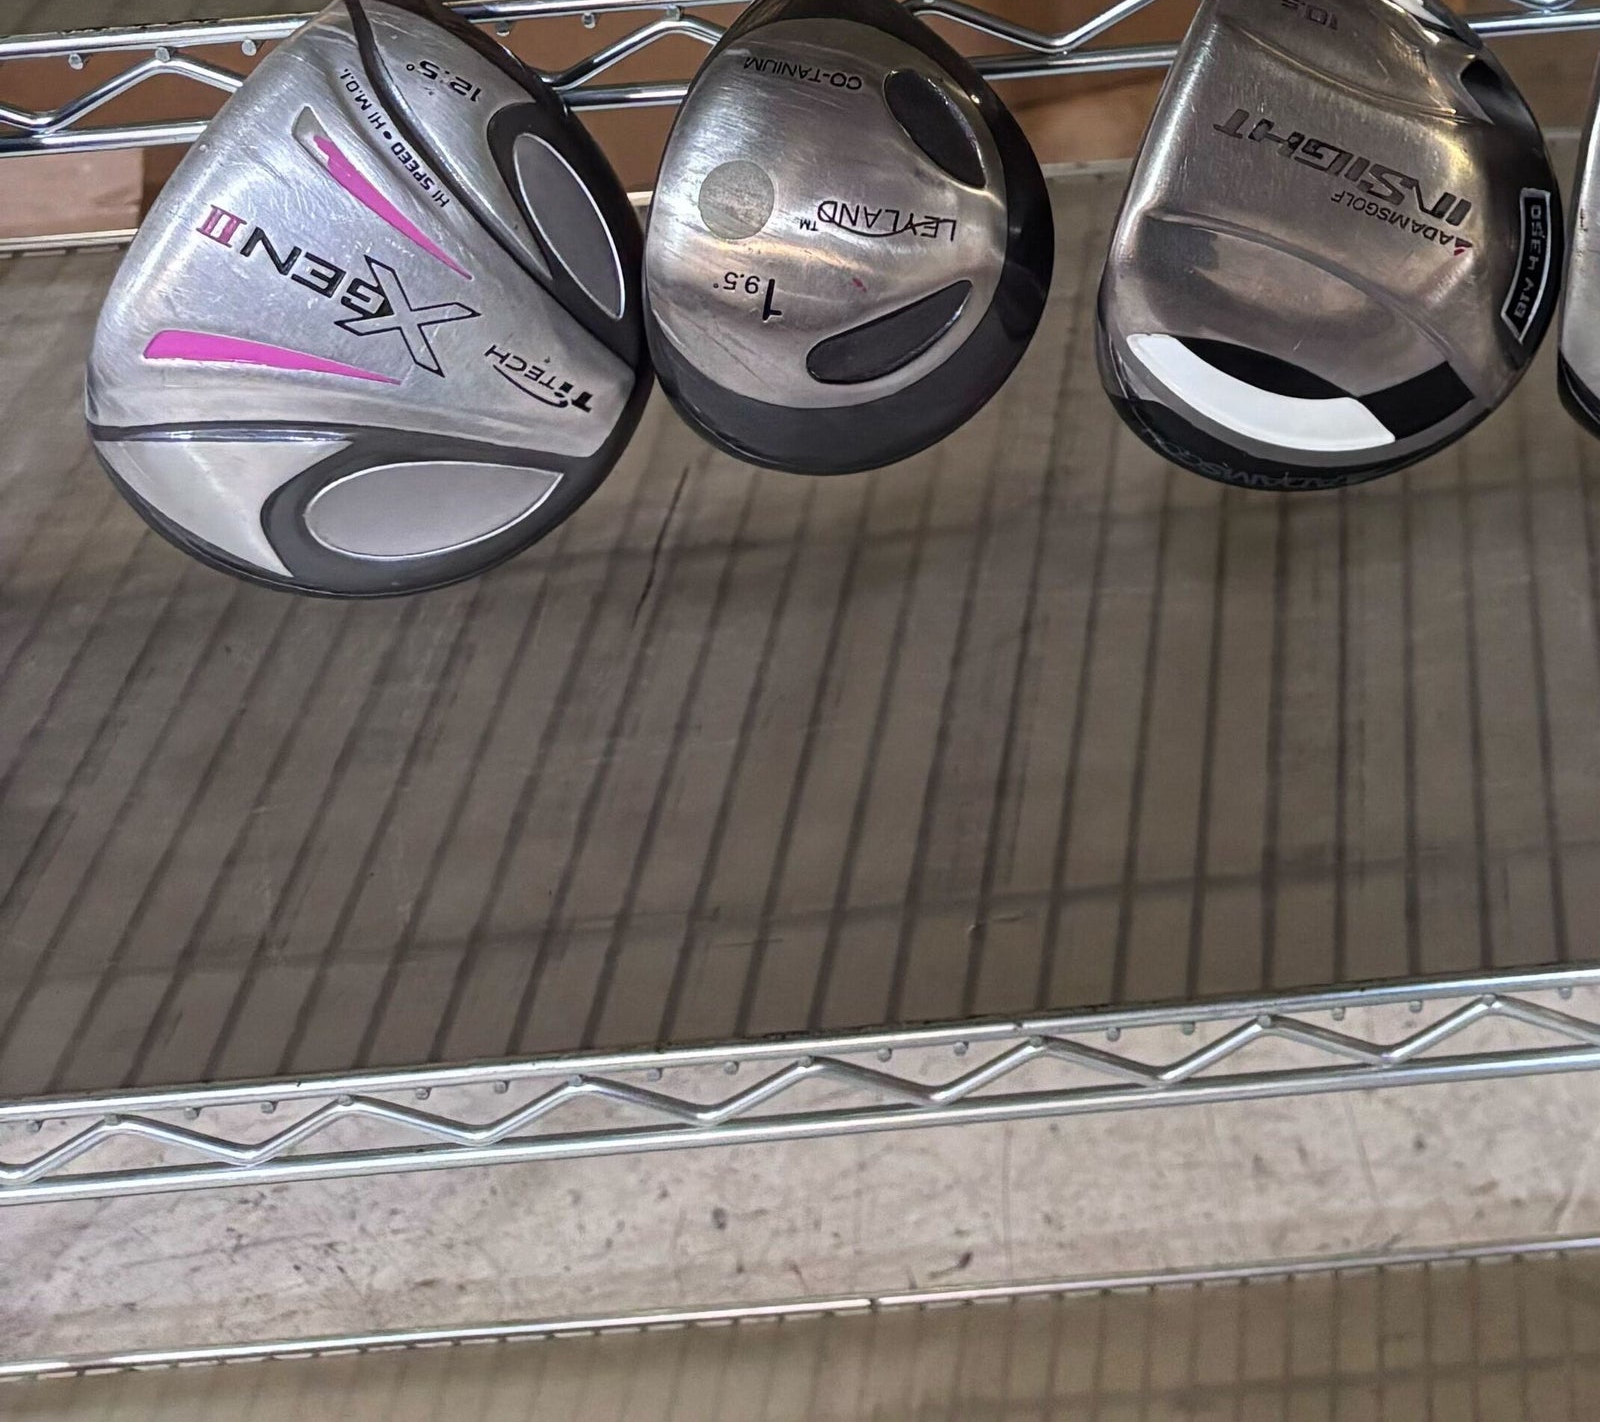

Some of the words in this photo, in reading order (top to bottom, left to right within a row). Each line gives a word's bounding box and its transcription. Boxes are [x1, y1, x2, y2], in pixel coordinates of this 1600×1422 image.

[742, 55, 864, 93] CO-TANIUM
[369, 106, 386, 131] HI
[391, 140, 436, 192] SPEED
[1213, 107, 1473, 228] INSIGHT
[431, 186, 451, 210] HI
[1330, 190, 1458, 252] ADAMSGOLF
